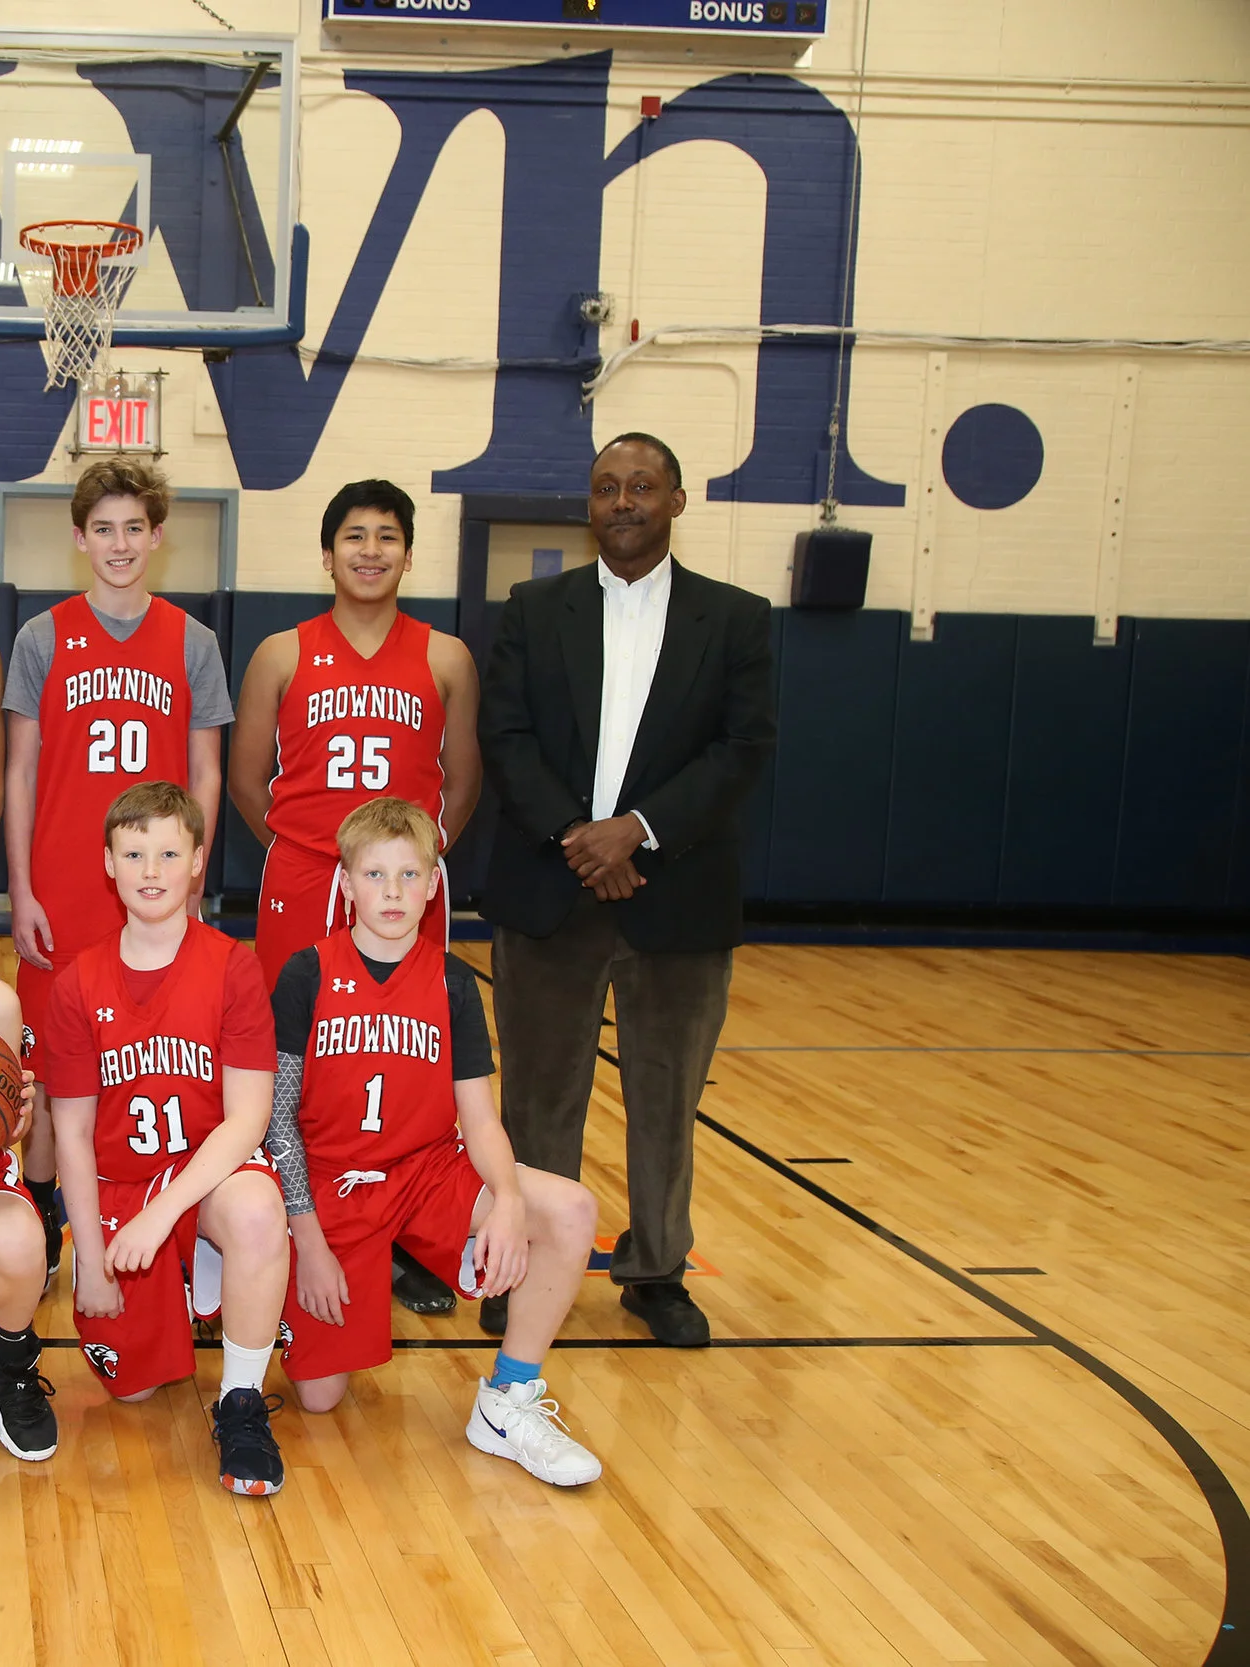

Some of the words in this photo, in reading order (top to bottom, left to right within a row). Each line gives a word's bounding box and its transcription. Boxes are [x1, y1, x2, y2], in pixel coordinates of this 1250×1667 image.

[689, 1, 764, 23] BONUS
[88, 399, 149, 445] EXIT
[64, 665, 174, 717] BROWNING
[306, 684, 424, 732] BROWNING
[87, 718, 150, 774] 20
[326, 734, 392, 791] 25
[314, 1013, 441, 1065] BROWNING
[127, 1095, 190, 1156] 31
[359, 1073, 384, 1133] 1
